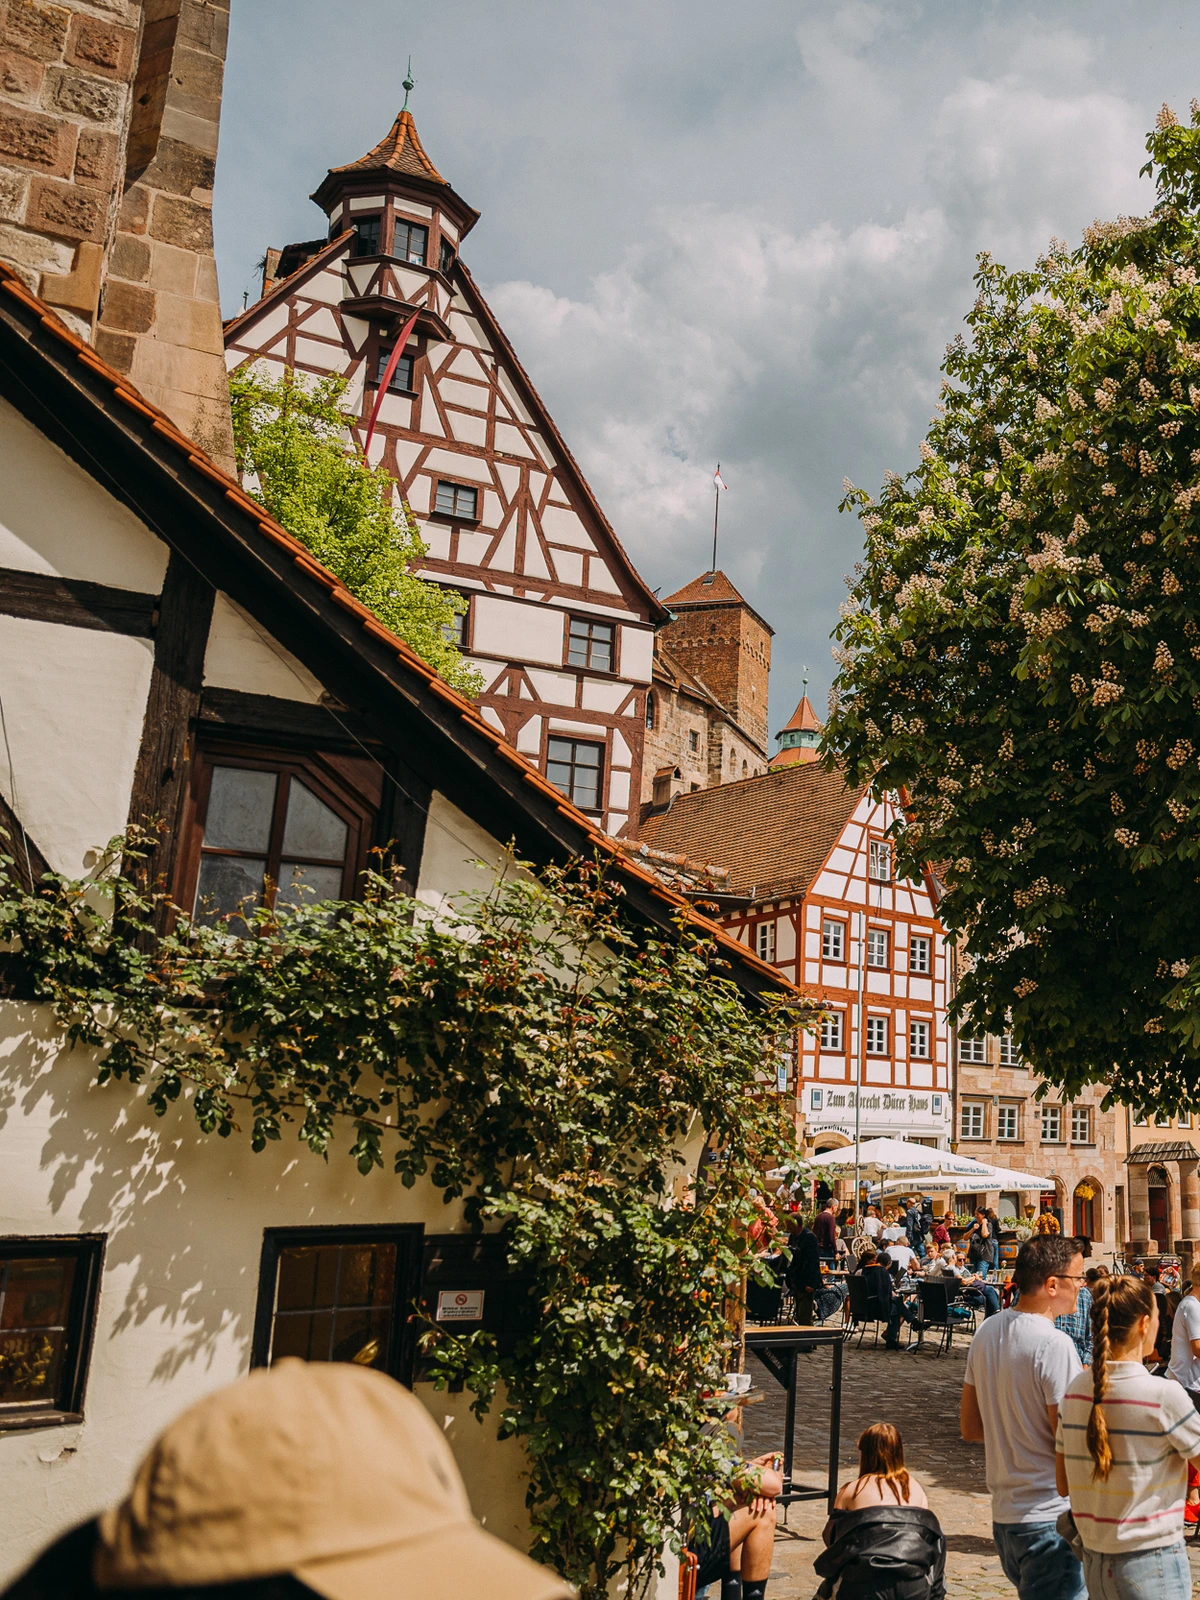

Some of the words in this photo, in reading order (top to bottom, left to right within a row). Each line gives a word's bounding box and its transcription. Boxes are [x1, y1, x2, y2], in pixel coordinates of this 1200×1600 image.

[826, 1090, 846, 1107] Zum
[882, 1093, 906, 1111] Dürer
[908, 1093, 929, 1113] Haus
